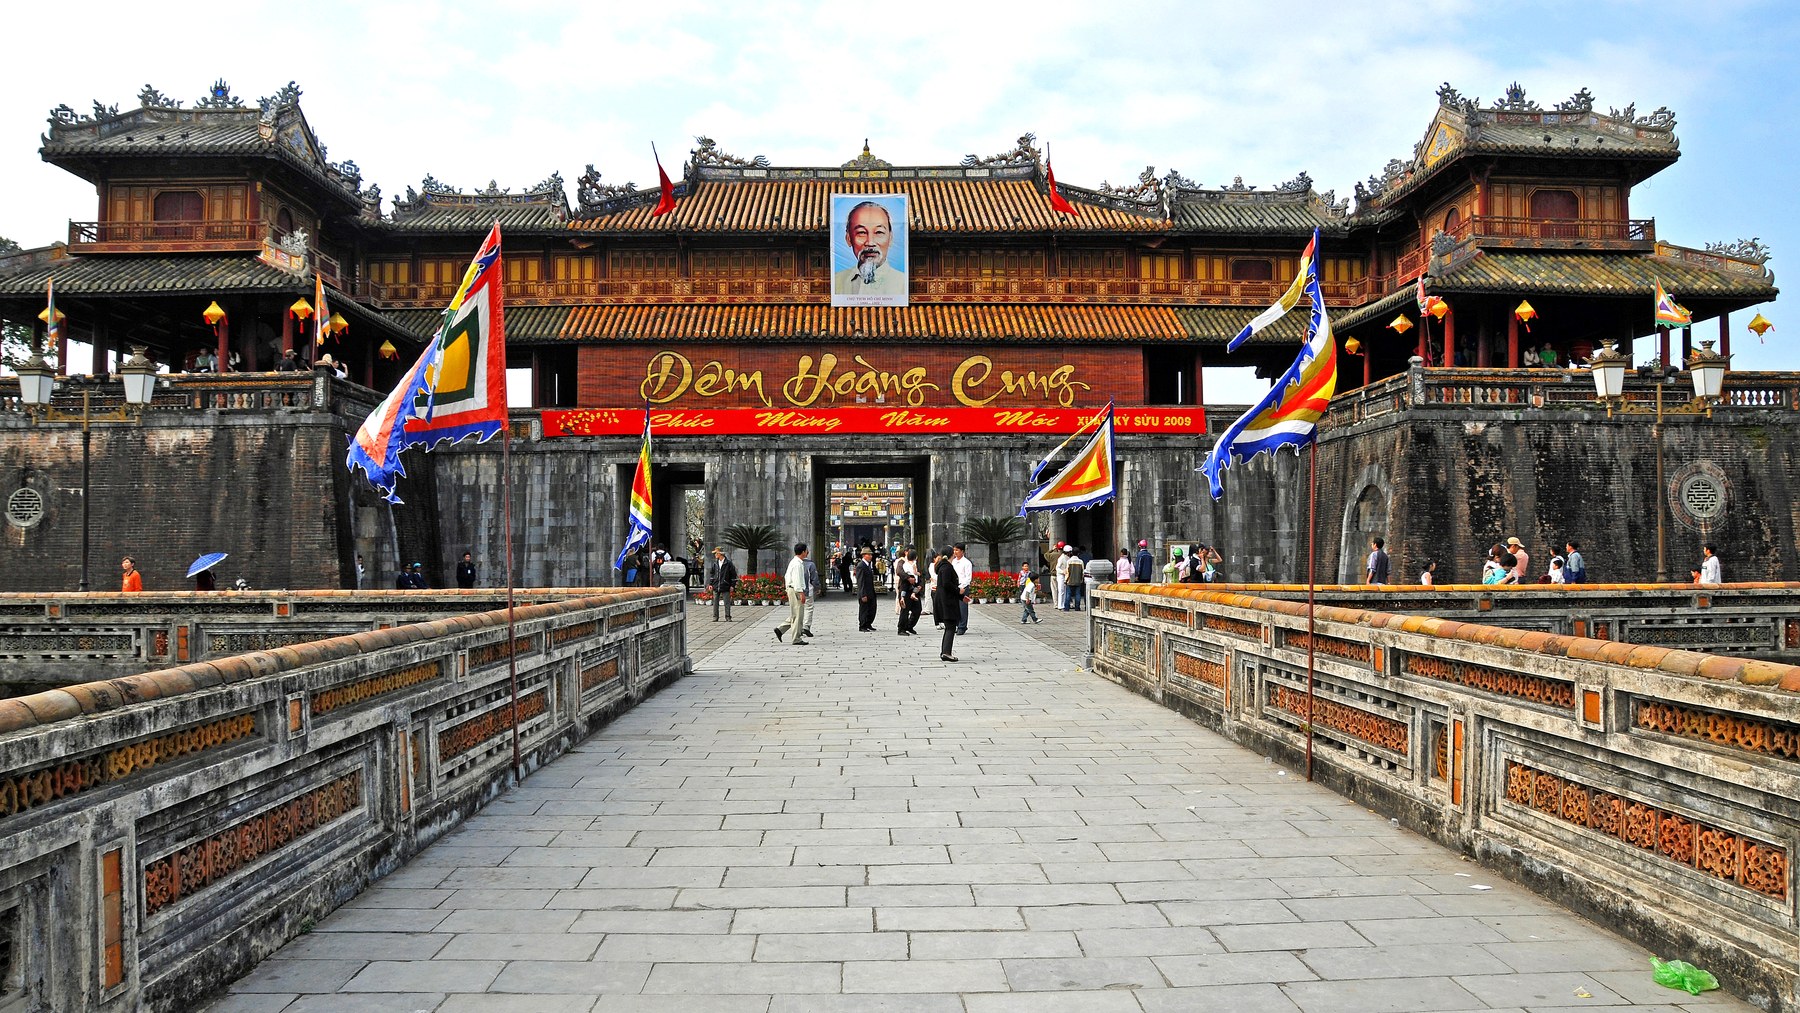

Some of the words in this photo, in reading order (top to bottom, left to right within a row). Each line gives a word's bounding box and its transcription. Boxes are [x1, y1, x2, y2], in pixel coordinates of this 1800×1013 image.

[783, 353, 940, 407] Hoàng
[952, 355, 1091, 408] Cung
[644, 413, 714, 427] Chúc
[754, 411, 842, 431] Mừng
[880, 411, 950, 427] Năm
[994, 412, 1059, 427] Mới
[1164, 416, 1191, 426] 2009
